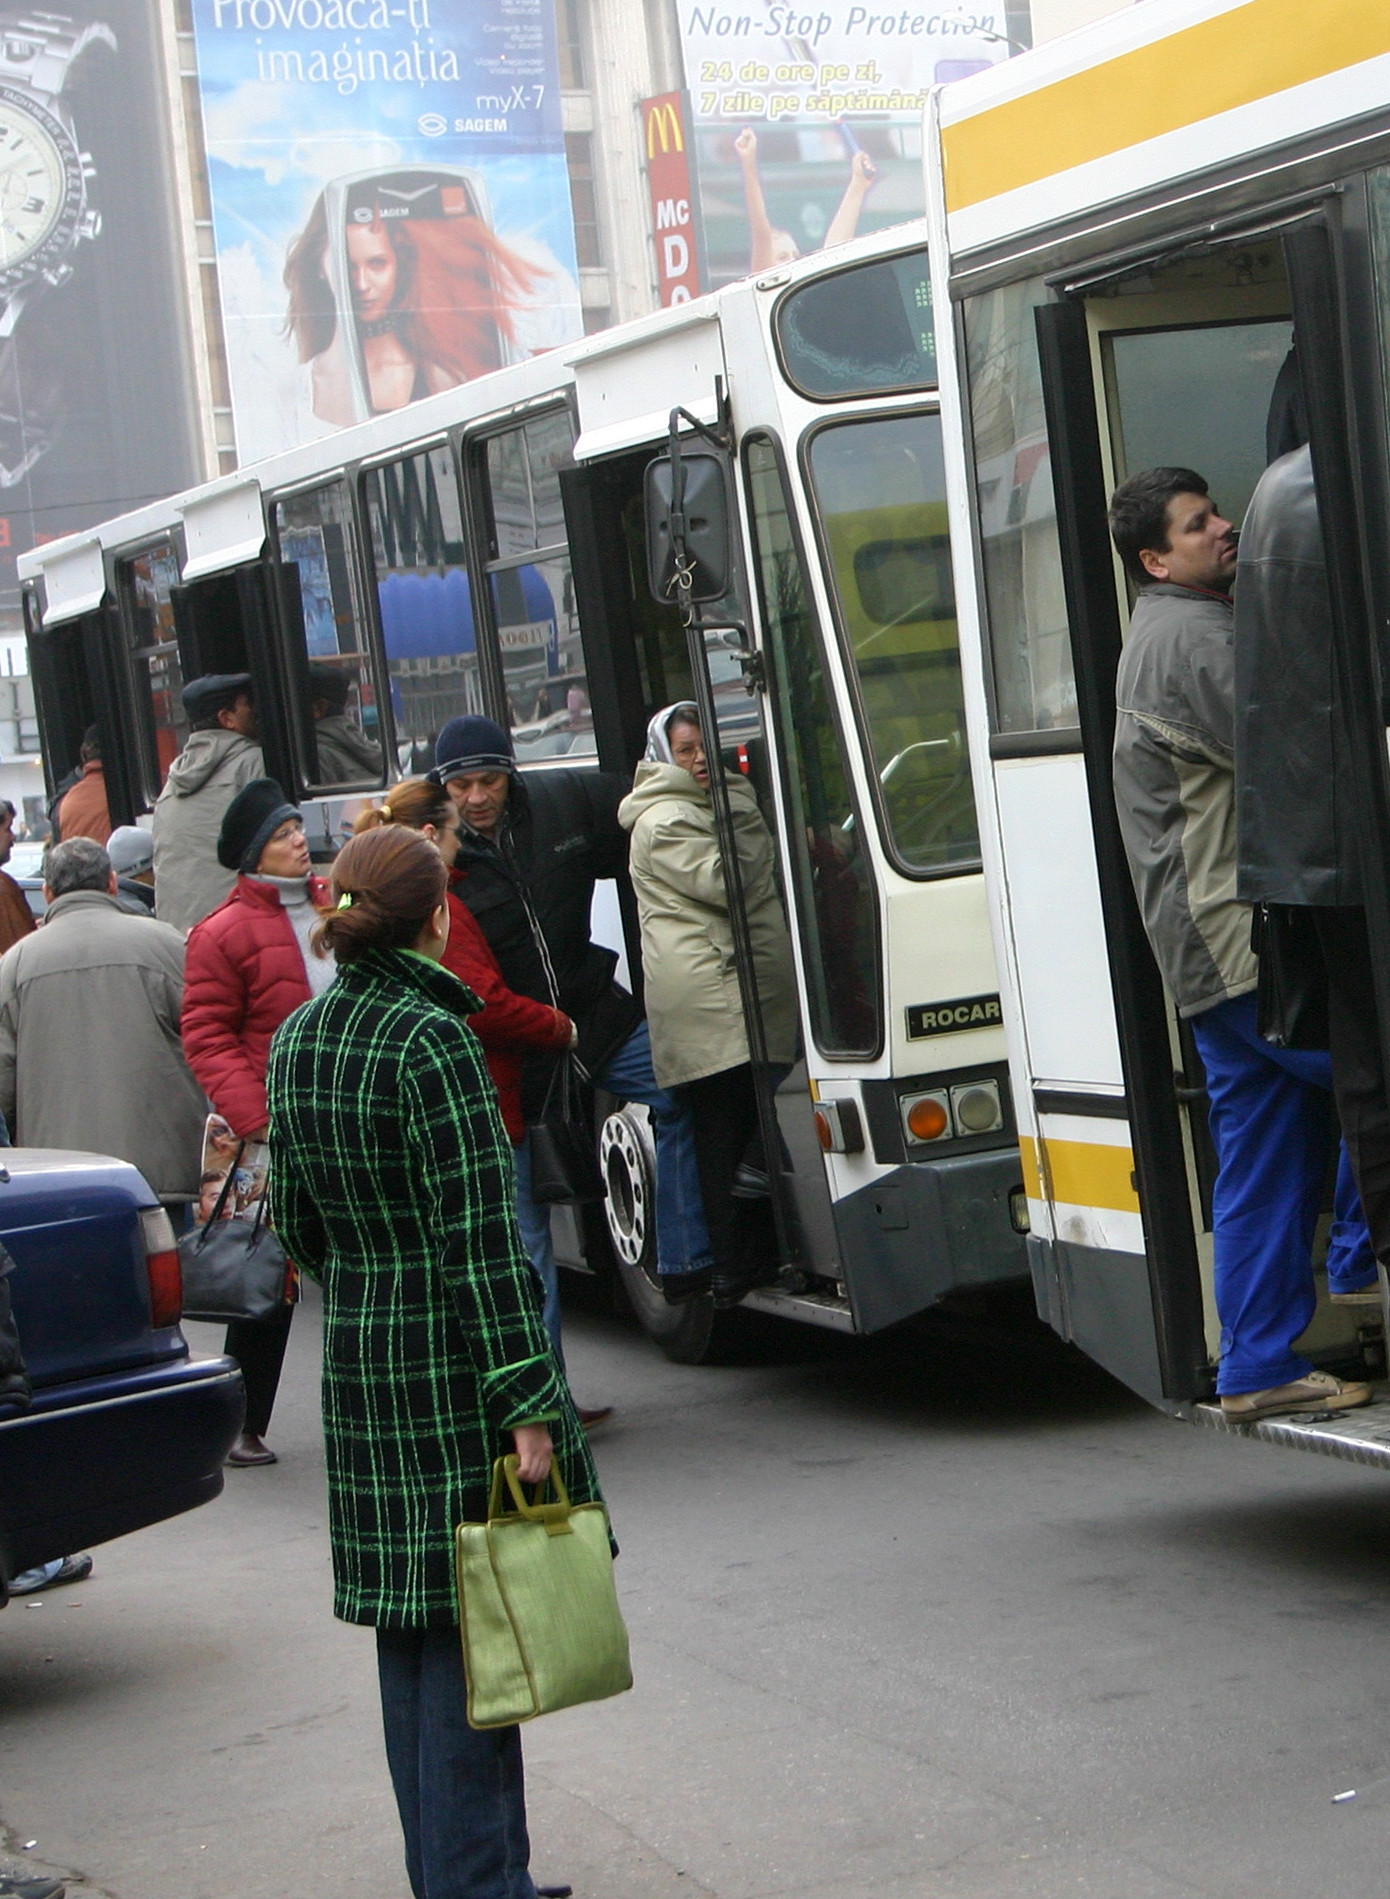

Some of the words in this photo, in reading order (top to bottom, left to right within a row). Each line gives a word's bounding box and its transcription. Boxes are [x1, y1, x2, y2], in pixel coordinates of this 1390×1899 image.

[688, 6, 832, 47] Non-Stop
[701, 61, 734, 83] 24
[739, 61, 770, 83] de
[775, 64, 816, 82] ore
[820, 64, 851, 87] pe
[855, 59, 883, 83] zi,
[476, 85, 544, 114] myX-7
[701, 91, 718, 113] 7
[723, 91, 766, 113] zile
[770, 95, 801, 118] pe
[455, 118, 508, 132] SAGEM
[921, 1001, 1000, 1029] ROCAR
